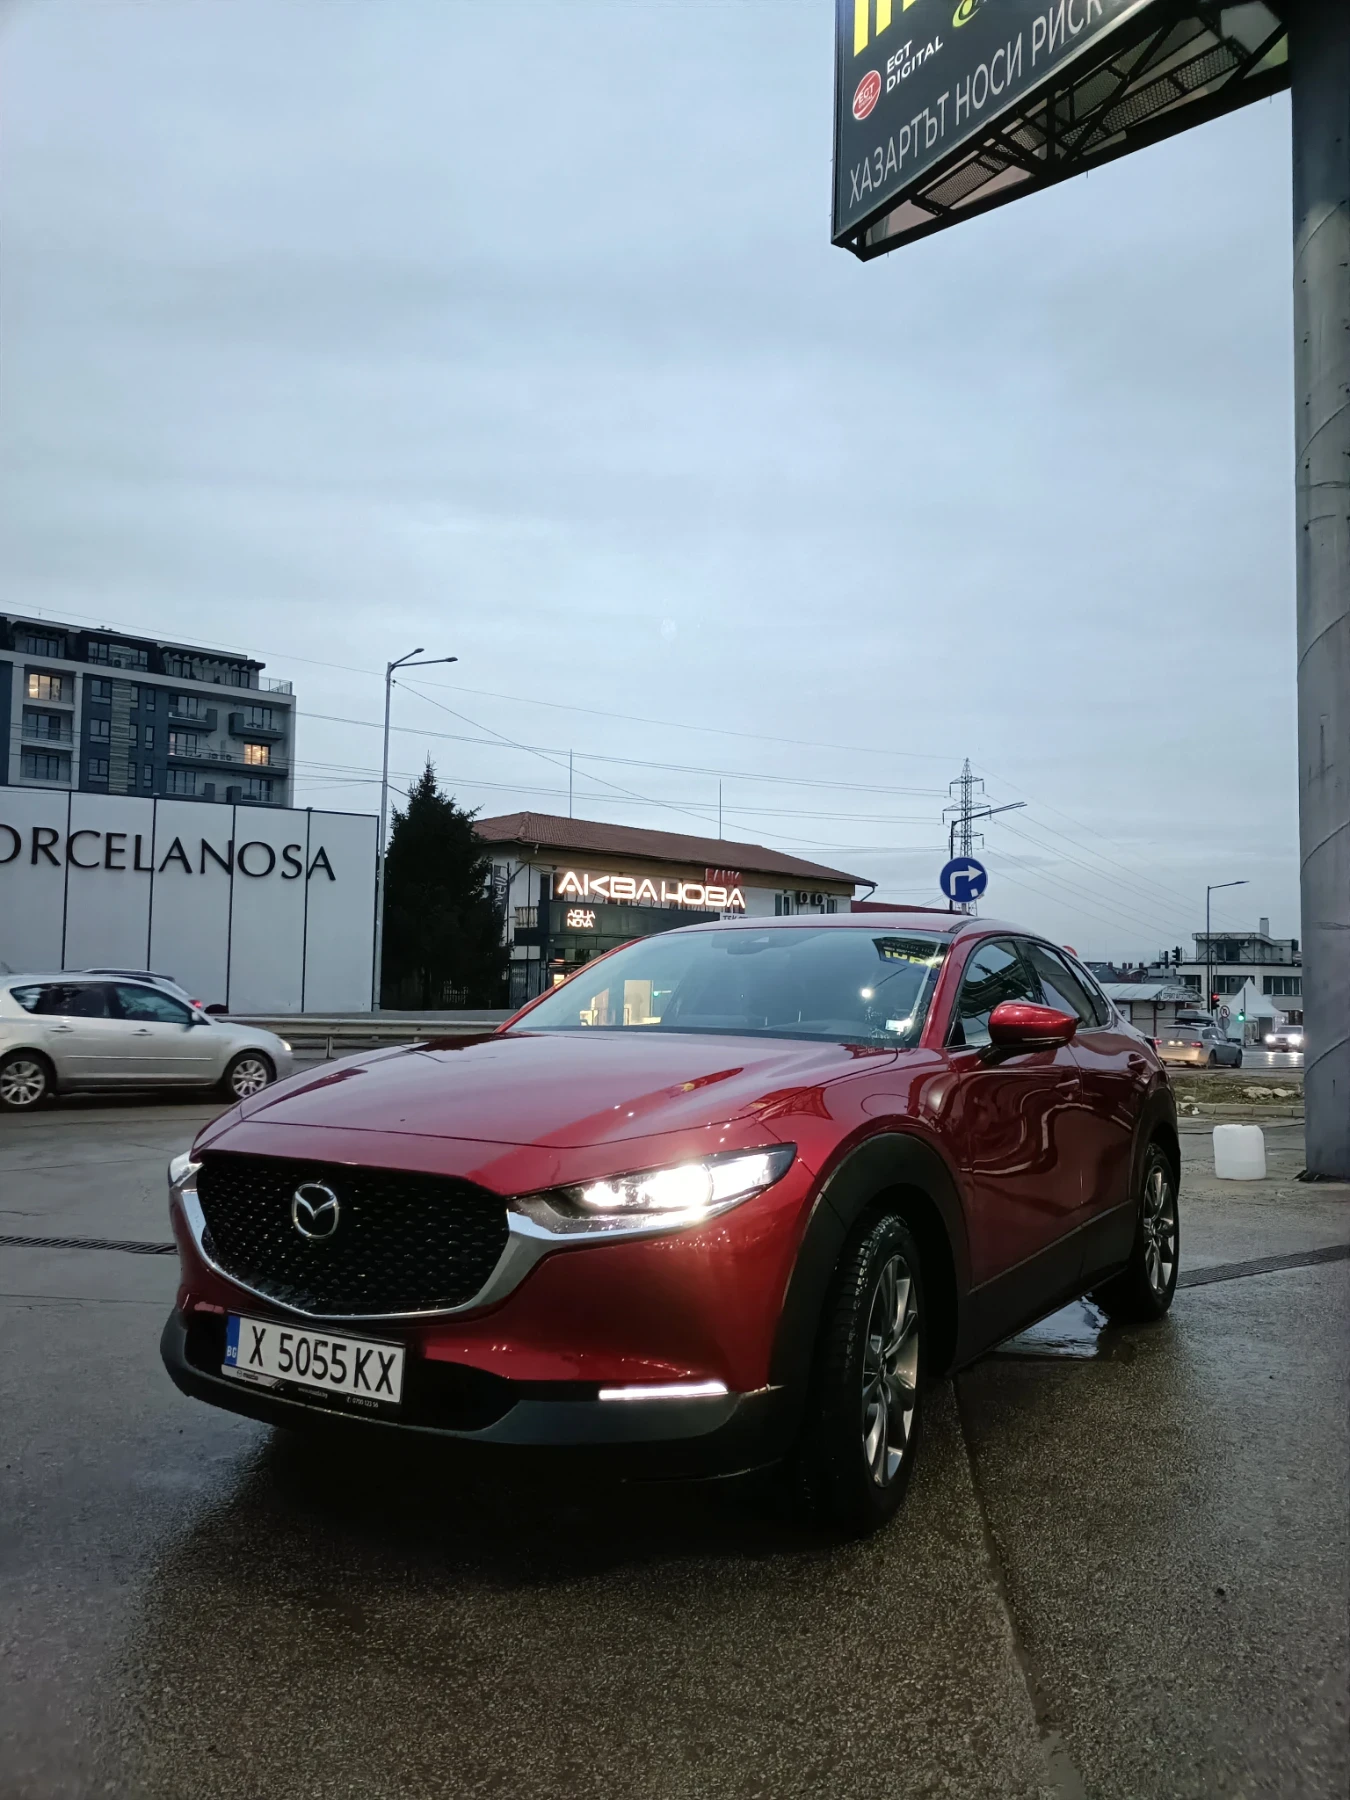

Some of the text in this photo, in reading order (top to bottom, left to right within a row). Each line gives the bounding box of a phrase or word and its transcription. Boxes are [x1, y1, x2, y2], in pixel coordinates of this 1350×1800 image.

[886, 39, 913, 75] EGT
[886, 35, 944, 94] DIGITAL
[849, 91, 950, 209] ХАЗАРТЪТ
[956, 32, 1023, 126] НОСИ
[566, 918, 594, 928] NOVA
[226, 1345, 237, 1358] BG
[249, 1325, 397, 1395] X 5055 KX
